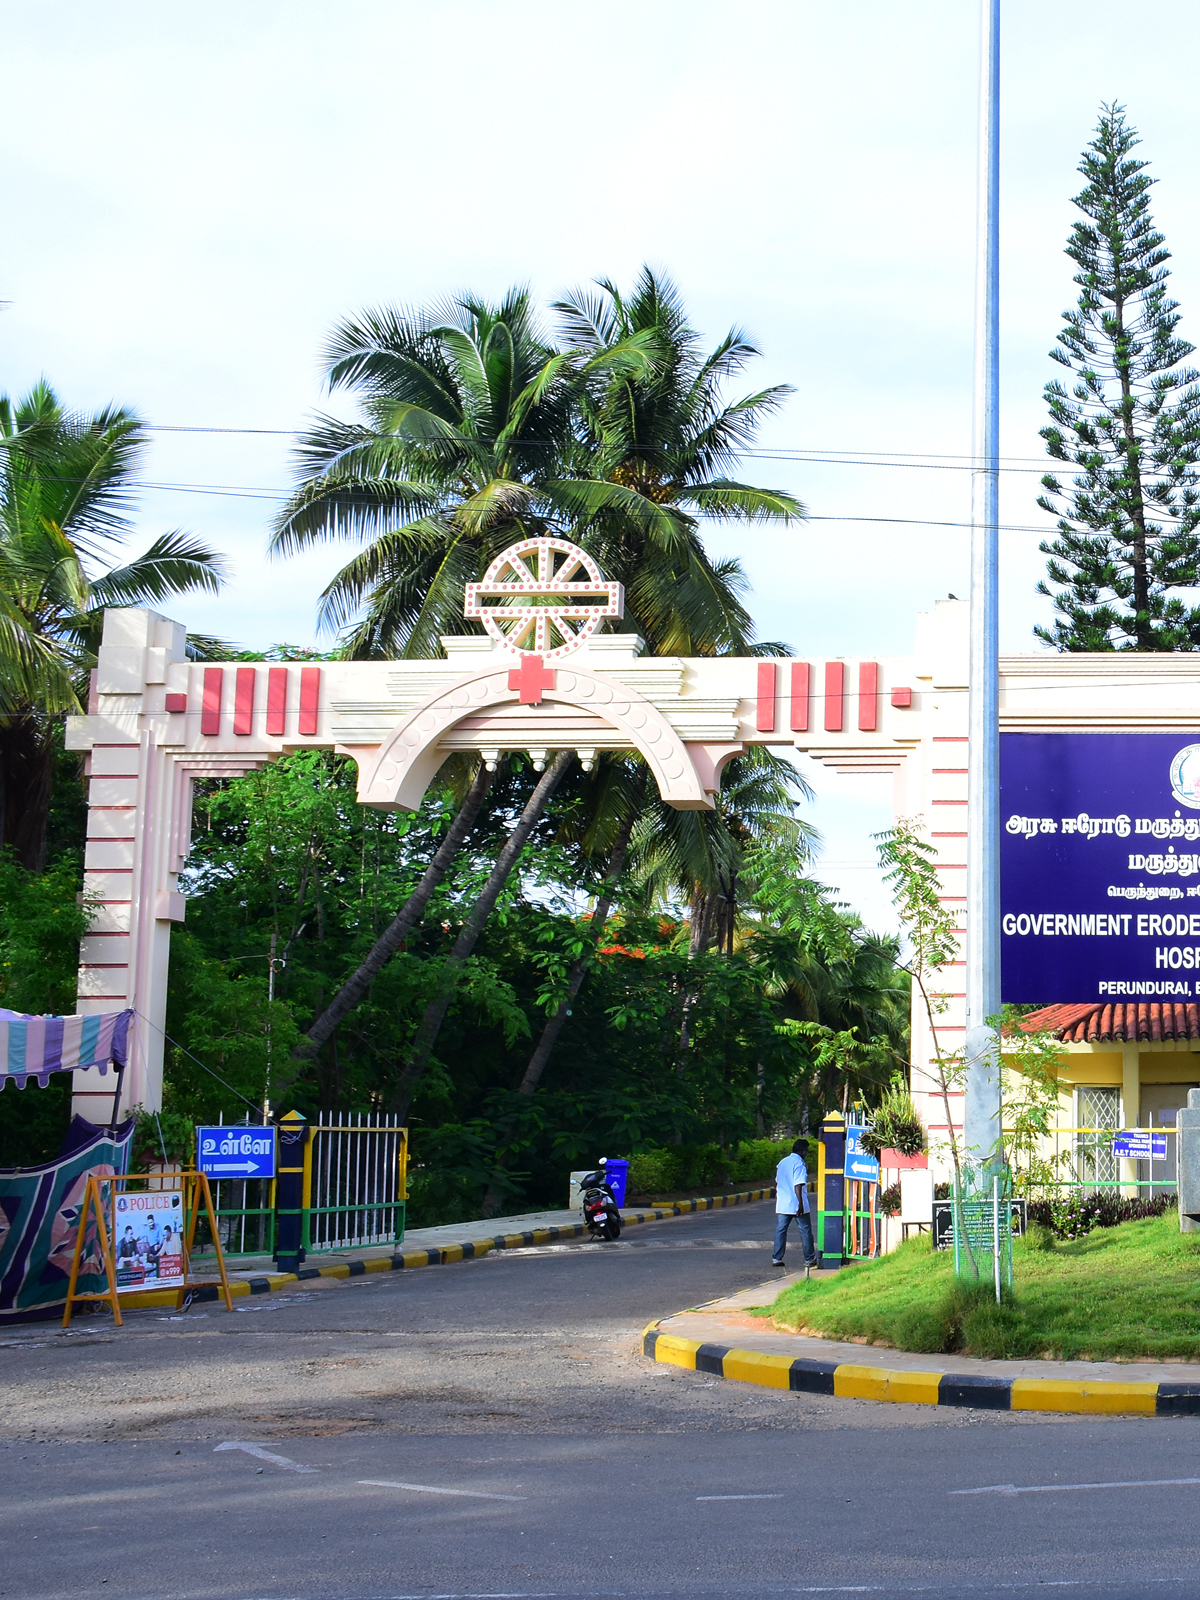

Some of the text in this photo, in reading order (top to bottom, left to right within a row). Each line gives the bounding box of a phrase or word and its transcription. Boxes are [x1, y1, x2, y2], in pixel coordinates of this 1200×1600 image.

[1005, 814, 1058, 839] அரசு
[1061, 813, 1132, 840] ஈரோடு
[1107, 882, 1185, 900] பெருந்துறை,
[1002, 913, 1133, 936] GOVERNMENT
[1137, 913, 1200, 936] ERODE
[1098, 981, 1192, 997] PERUNDURAI,
[202, 1131, 272, 1155] உள்ளே
[202, 1163, 213, 1172] IN
[130, 1196, 170, 1211] POLICE
